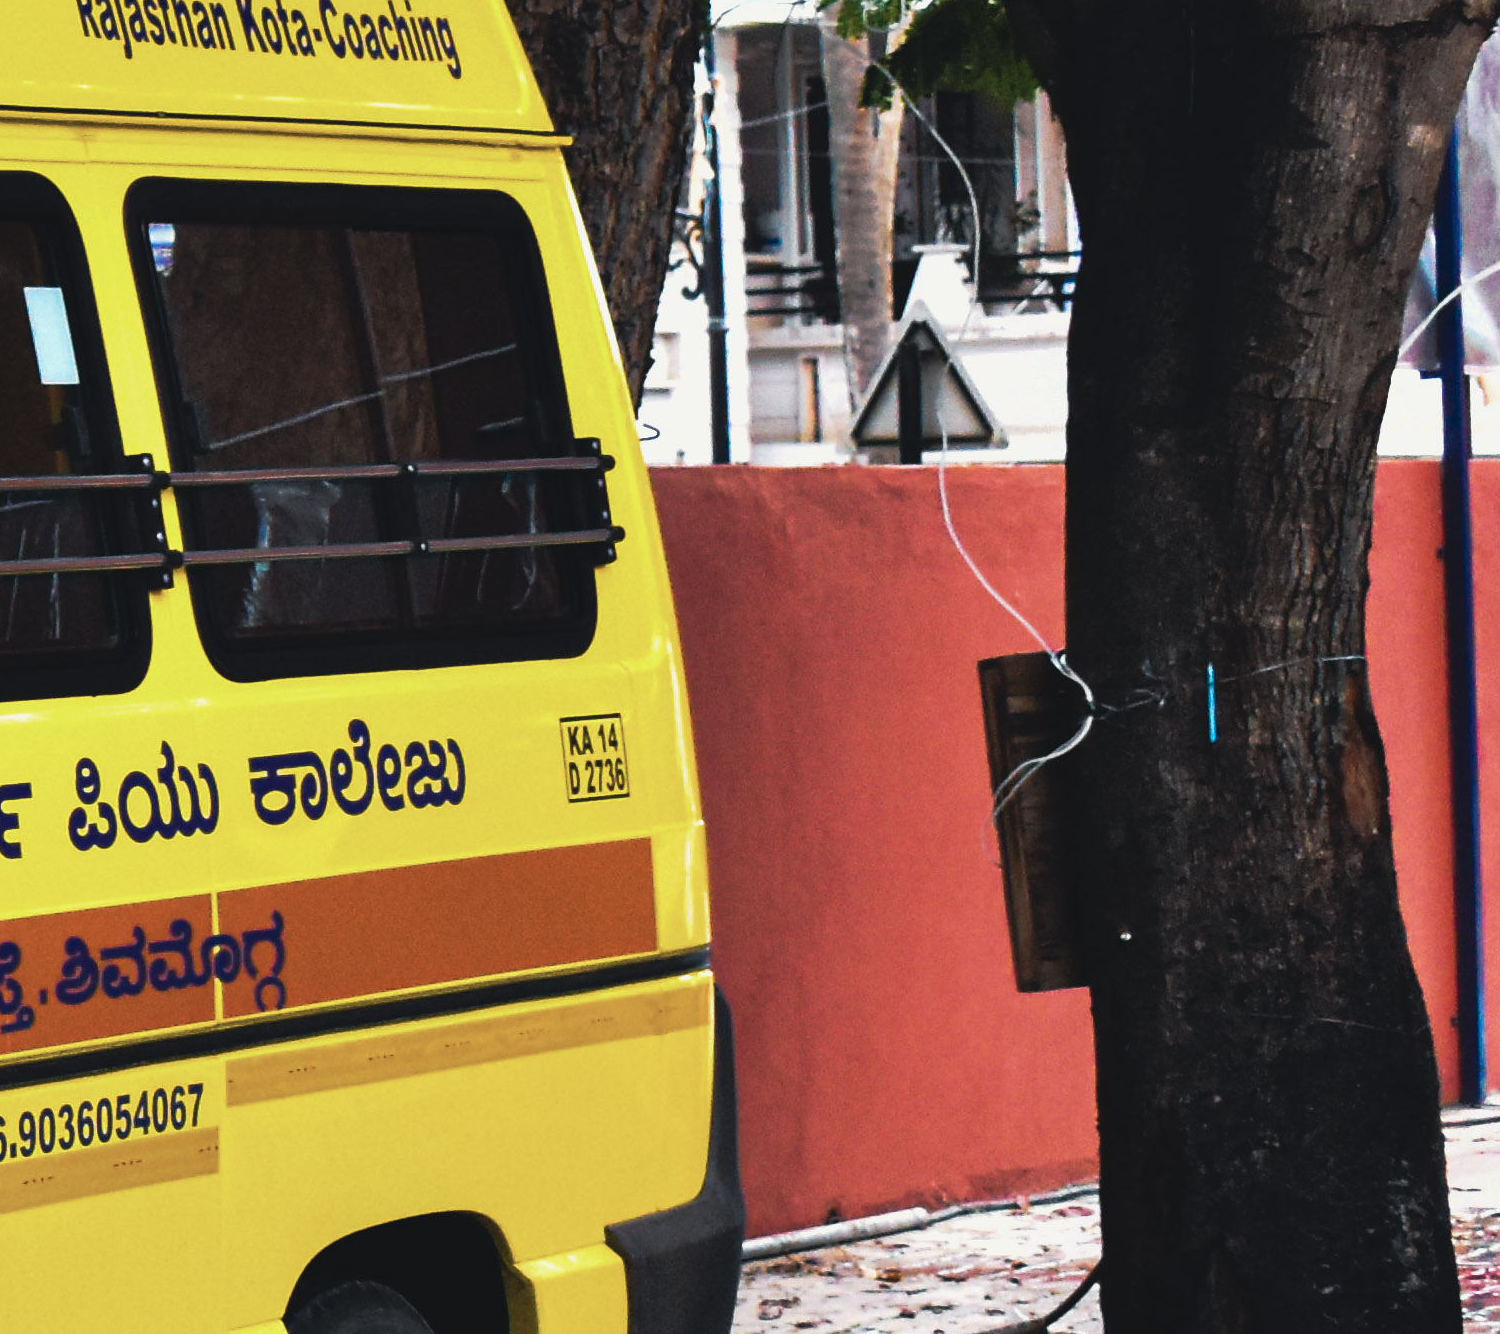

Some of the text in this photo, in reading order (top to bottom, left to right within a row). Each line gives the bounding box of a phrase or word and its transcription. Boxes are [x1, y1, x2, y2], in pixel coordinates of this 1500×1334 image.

[568, 723, 618, 756] KA 14
[68, 740, 220, 852] ಪಿಯು
[248, 718, 466, 826] ಕಾಲೇಜು
[569, 757, 625, 795] D 2736
